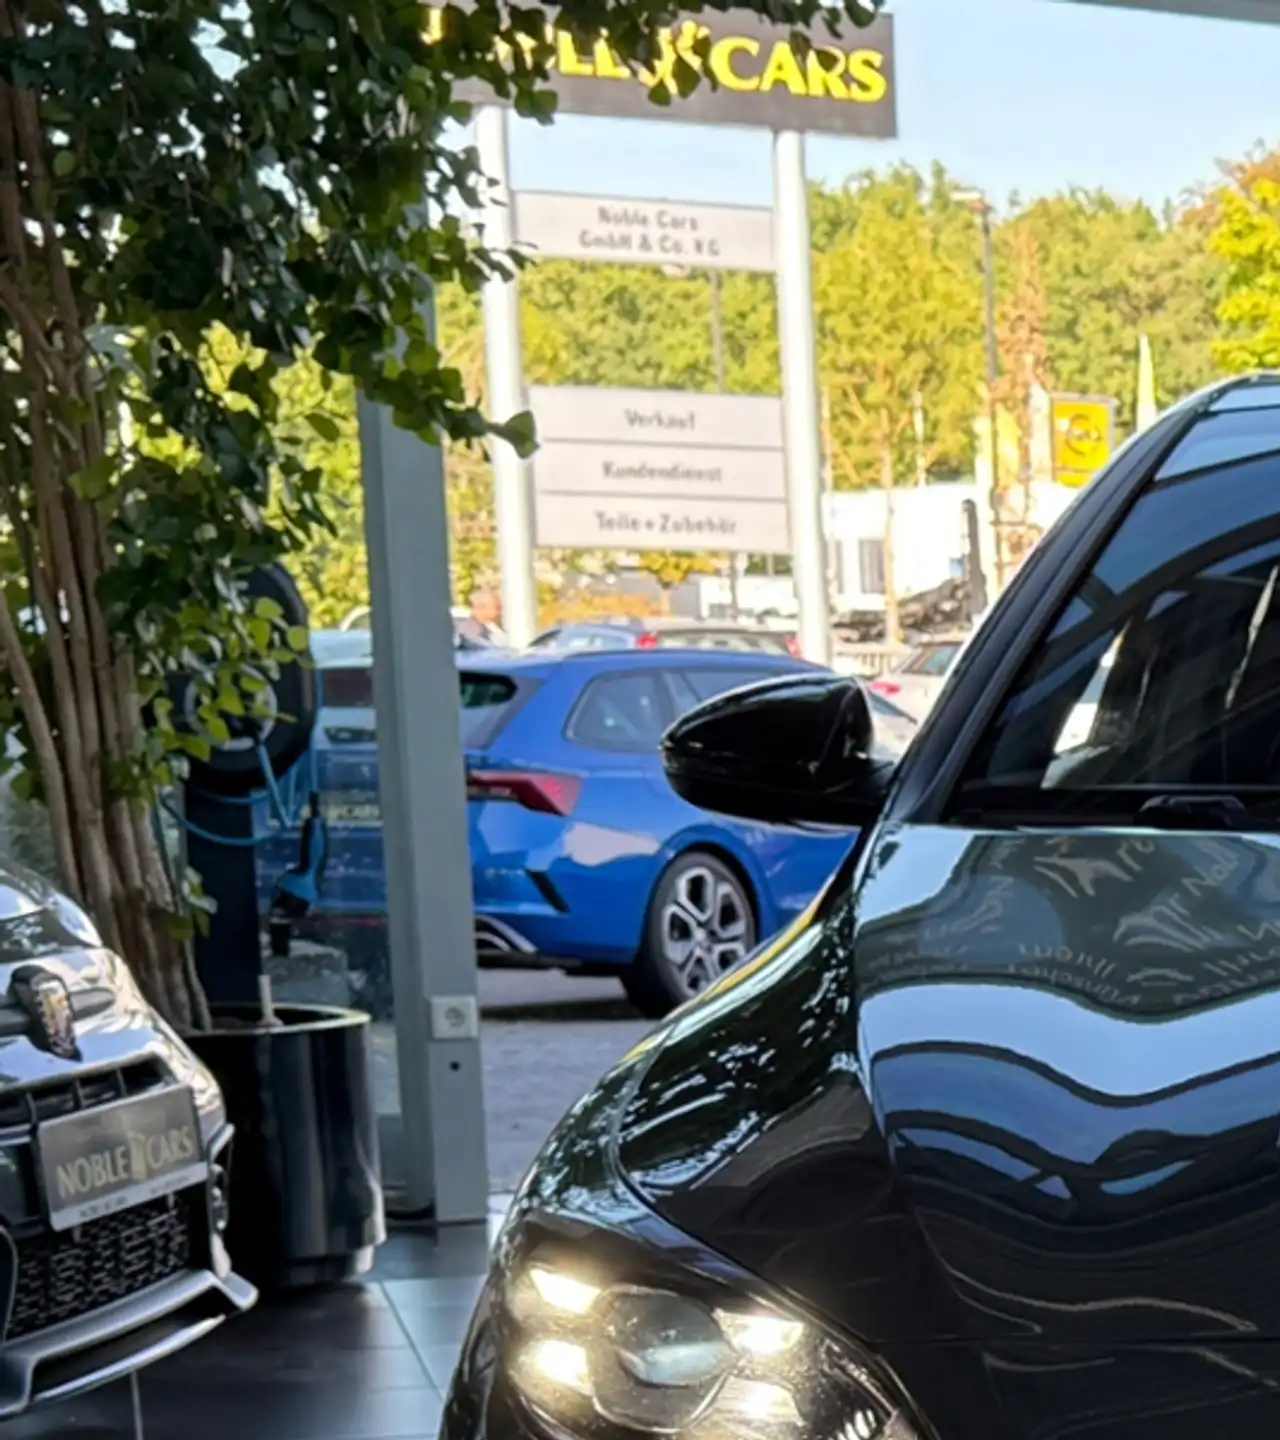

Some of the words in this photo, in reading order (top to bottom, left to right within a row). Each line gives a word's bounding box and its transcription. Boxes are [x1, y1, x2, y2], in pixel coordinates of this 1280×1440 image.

[709, 36, 888, 102] CARS
[624, 408, 696, 430] Verkauf
[594, 510, 641, 532] Teile
[55, 1145, 129, 1200] NOBLE
[147, 1125, 194, 1170] CARS
